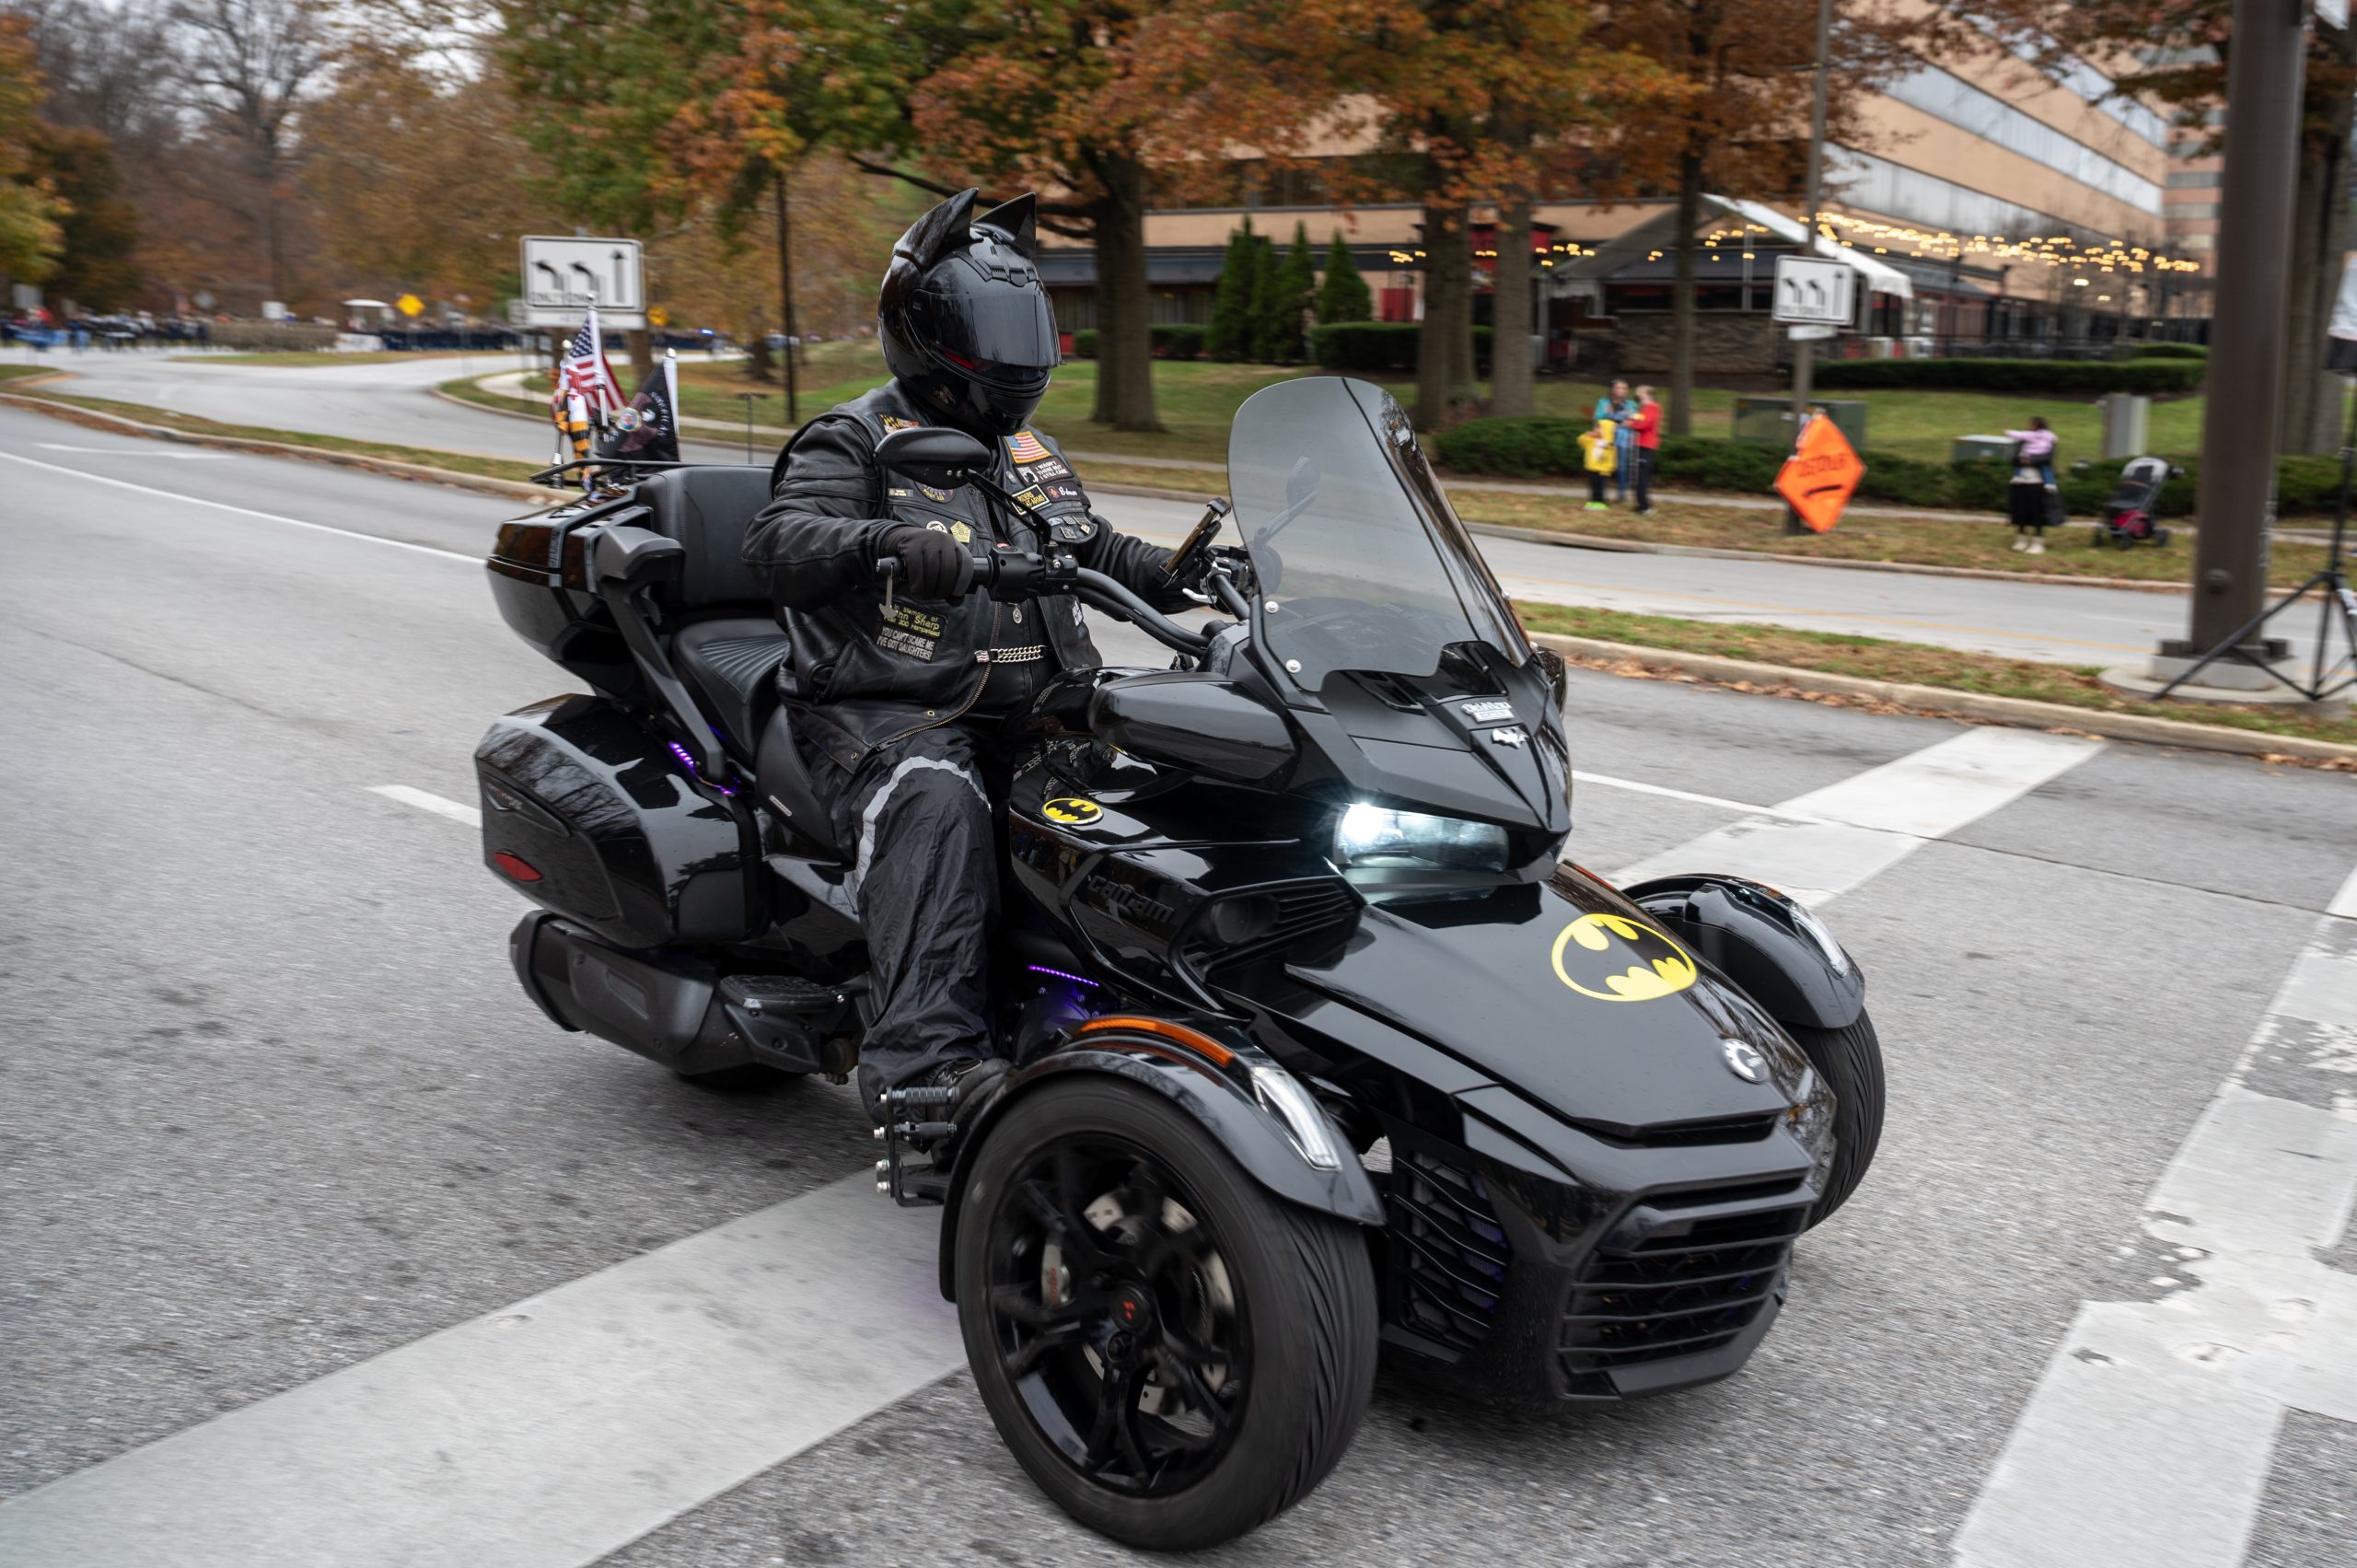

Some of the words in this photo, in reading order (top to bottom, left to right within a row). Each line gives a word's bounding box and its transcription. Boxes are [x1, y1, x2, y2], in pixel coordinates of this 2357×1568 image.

[1037, 467, 1052, 475] THERE
[1042, 471, 1057, 480] STILL
[903, 608, 926, 619] Memory
[898, 619, 910, 627] 200
[911, 623, 941, 637] Hampstead
[914, 614, 940, 630] Sharp
[883, 627, 893, 637] YOU
[892, 630, 910, 643] CAN'T
[907, 634, 926, 648] SCARE
[925, 640, 935, 650] ME
[877, 635, 888, 647] I'VE
[887, 639, 900, 651] GOT
[899, 644, 933, 660] DAUGHTERS!
